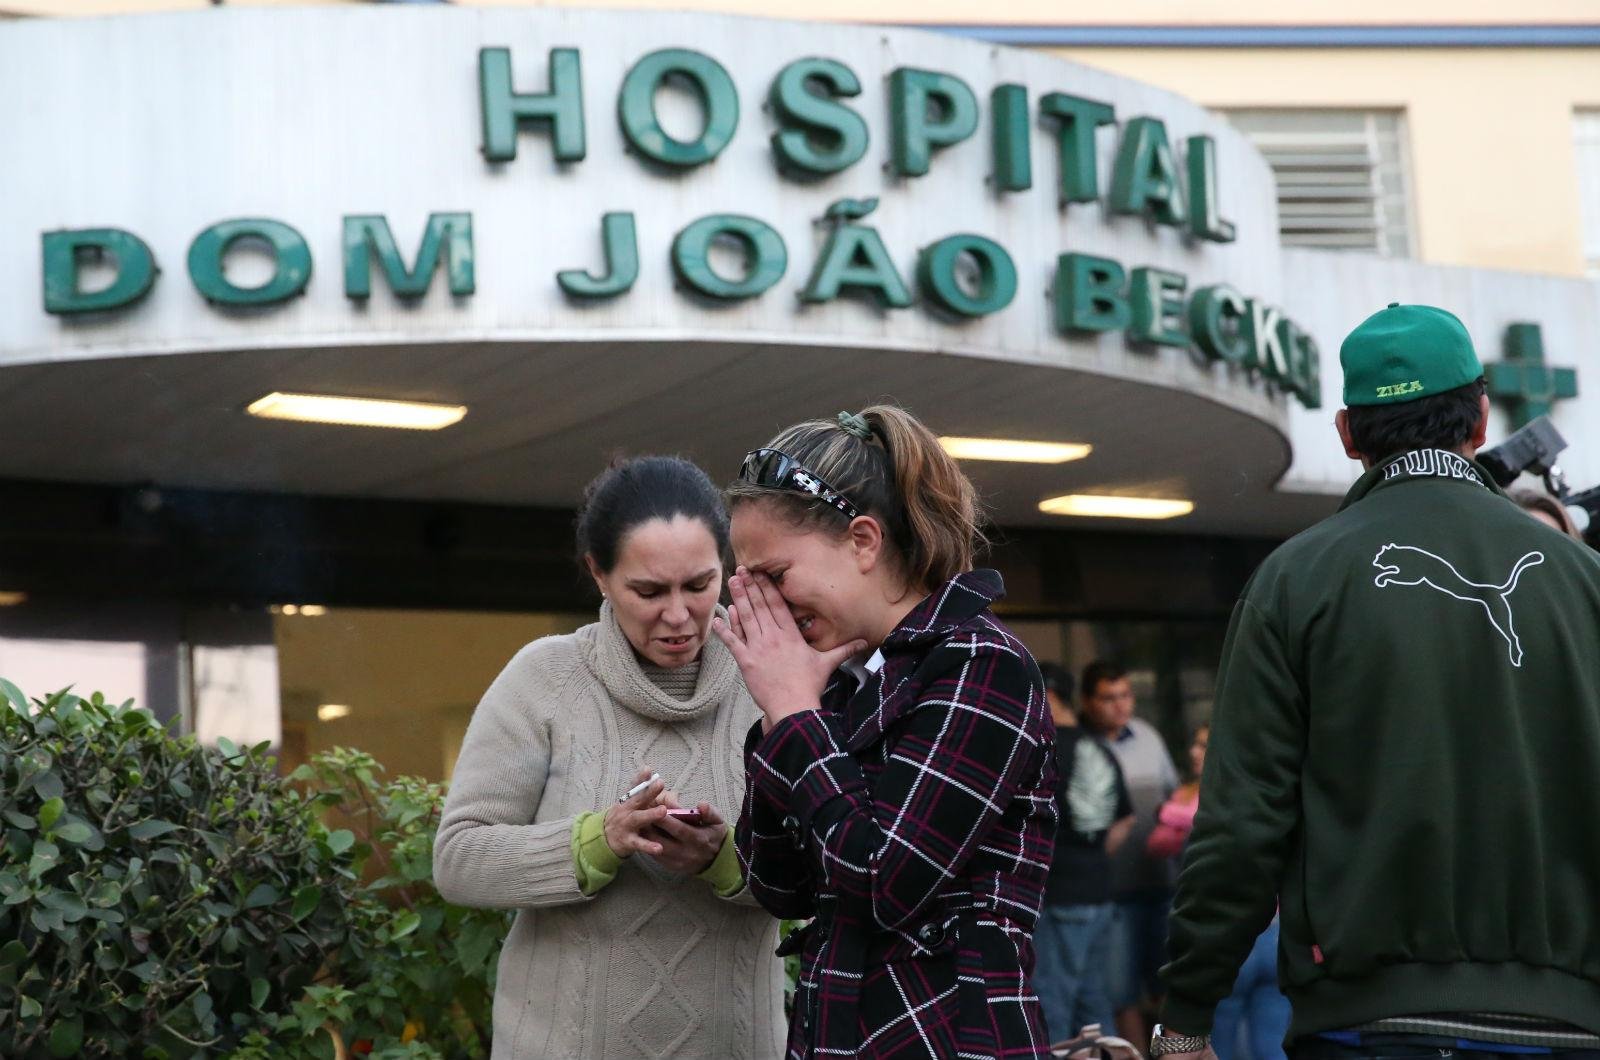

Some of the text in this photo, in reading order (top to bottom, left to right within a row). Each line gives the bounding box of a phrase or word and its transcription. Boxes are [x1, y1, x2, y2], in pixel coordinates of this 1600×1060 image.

[479, 46, 1235, 243] HOSPITAL
[41, 211, 476, 315] DOM
[556, 197, 1018, 317] JOÃO
[1376, 380, 1424, 398] ZIKA
